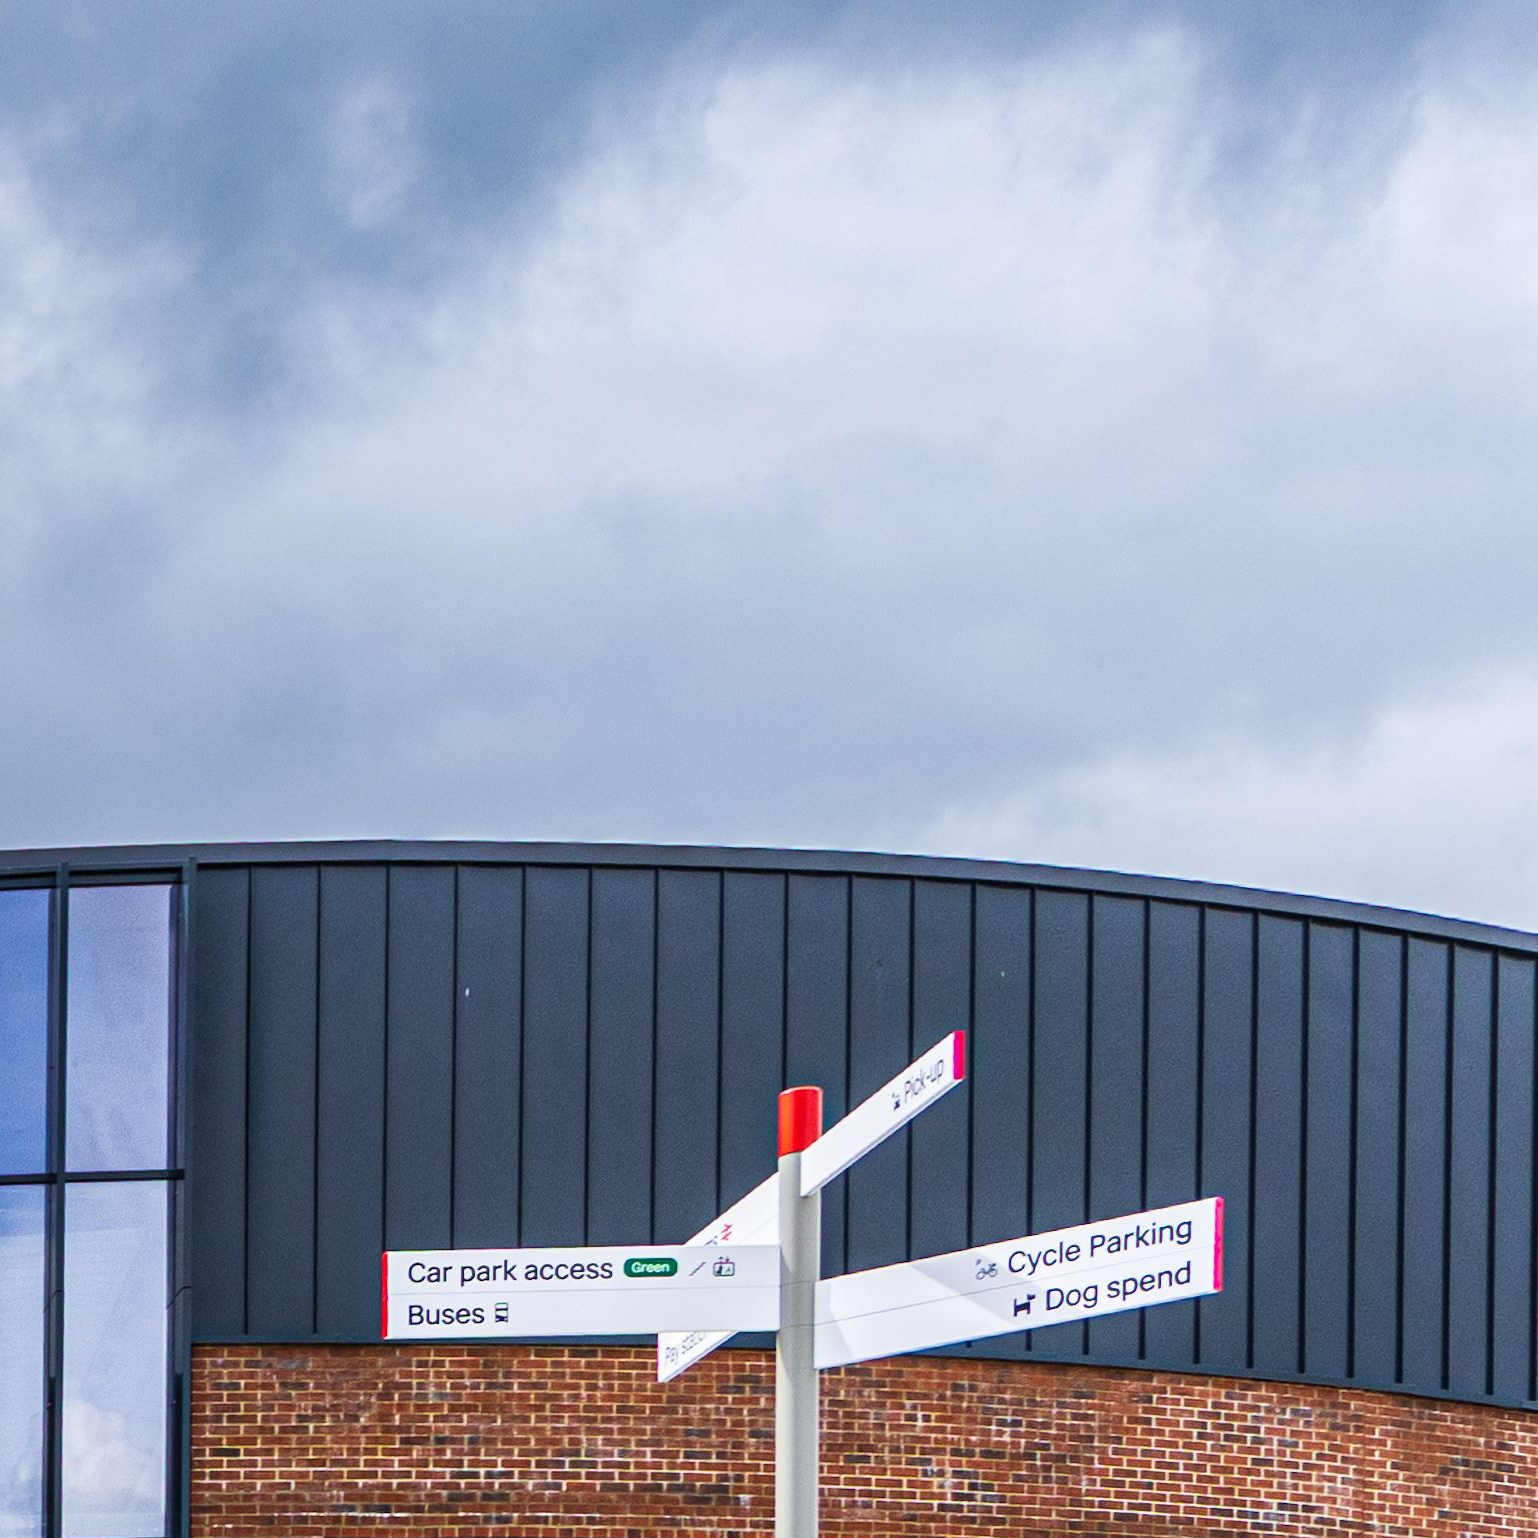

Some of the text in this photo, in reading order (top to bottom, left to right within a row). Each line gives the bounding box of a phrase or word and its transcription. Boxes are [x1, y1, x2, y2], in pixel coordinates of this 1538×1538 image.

[1008, 1220, 1192, 1276] Cycle Parking
[408, 1259, 670, 1287] Car park access Green
[1046, 1260, 1191, 1311] Dog spend
[408, 1305, 485, 1325] Buses
